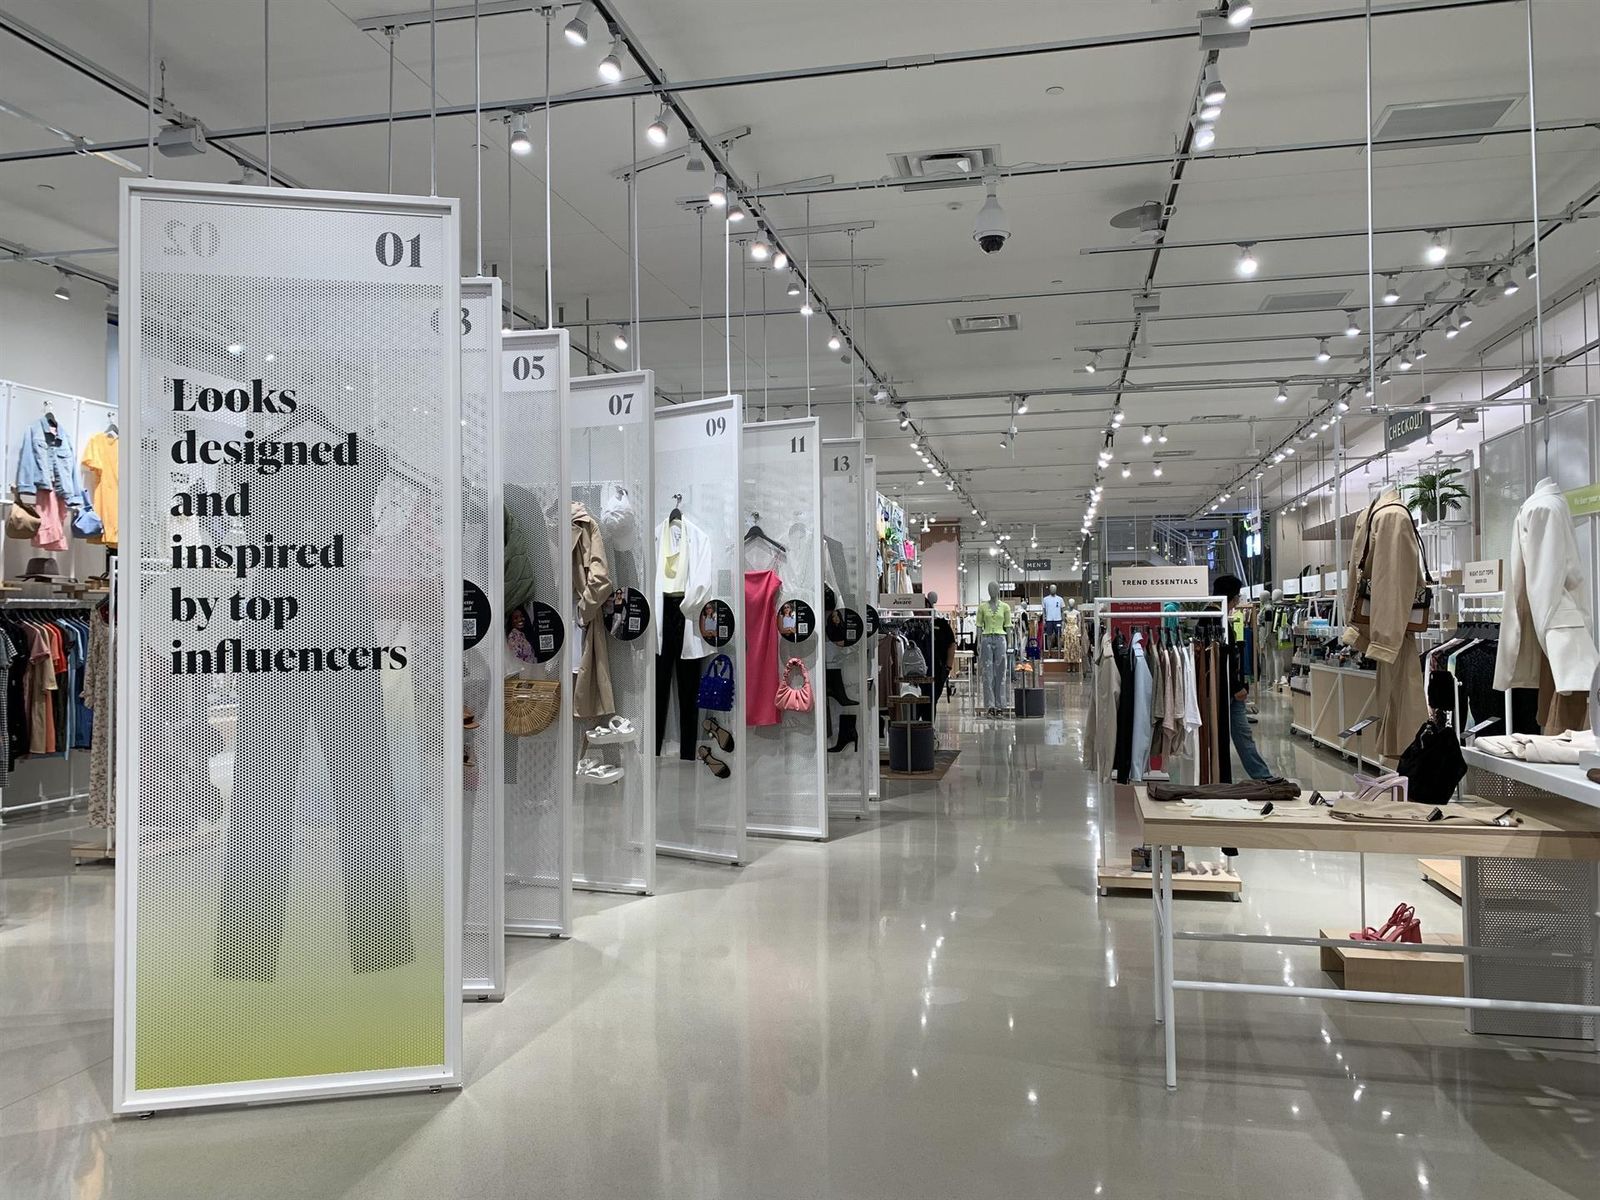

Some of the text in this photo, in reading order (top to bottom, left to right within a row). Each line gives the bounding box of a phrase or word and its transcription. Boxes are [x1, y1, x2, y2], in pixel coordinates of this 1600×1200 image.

[375, 231, 422, 268] 01
[512, 355, 545, 380] 05
[171, 378, 298, 414] Looks
[608, 393, 634, 416] 07
[705, 416, 727, 437] 09
[1388, 410, 1424, 440] CHECKOUT
[170, 430, 360, 475] designed
[789, 436, 805, 453] 11
[833, 455, 850, 472] 13
[170, 482, 251, 517] and
[170, 534, 346, 579] inspired
[1150, 578, 1199, 586] ESSENTIALS
[170, 587, 299, 631] by top
[170, 639, 408, 675] influencers
